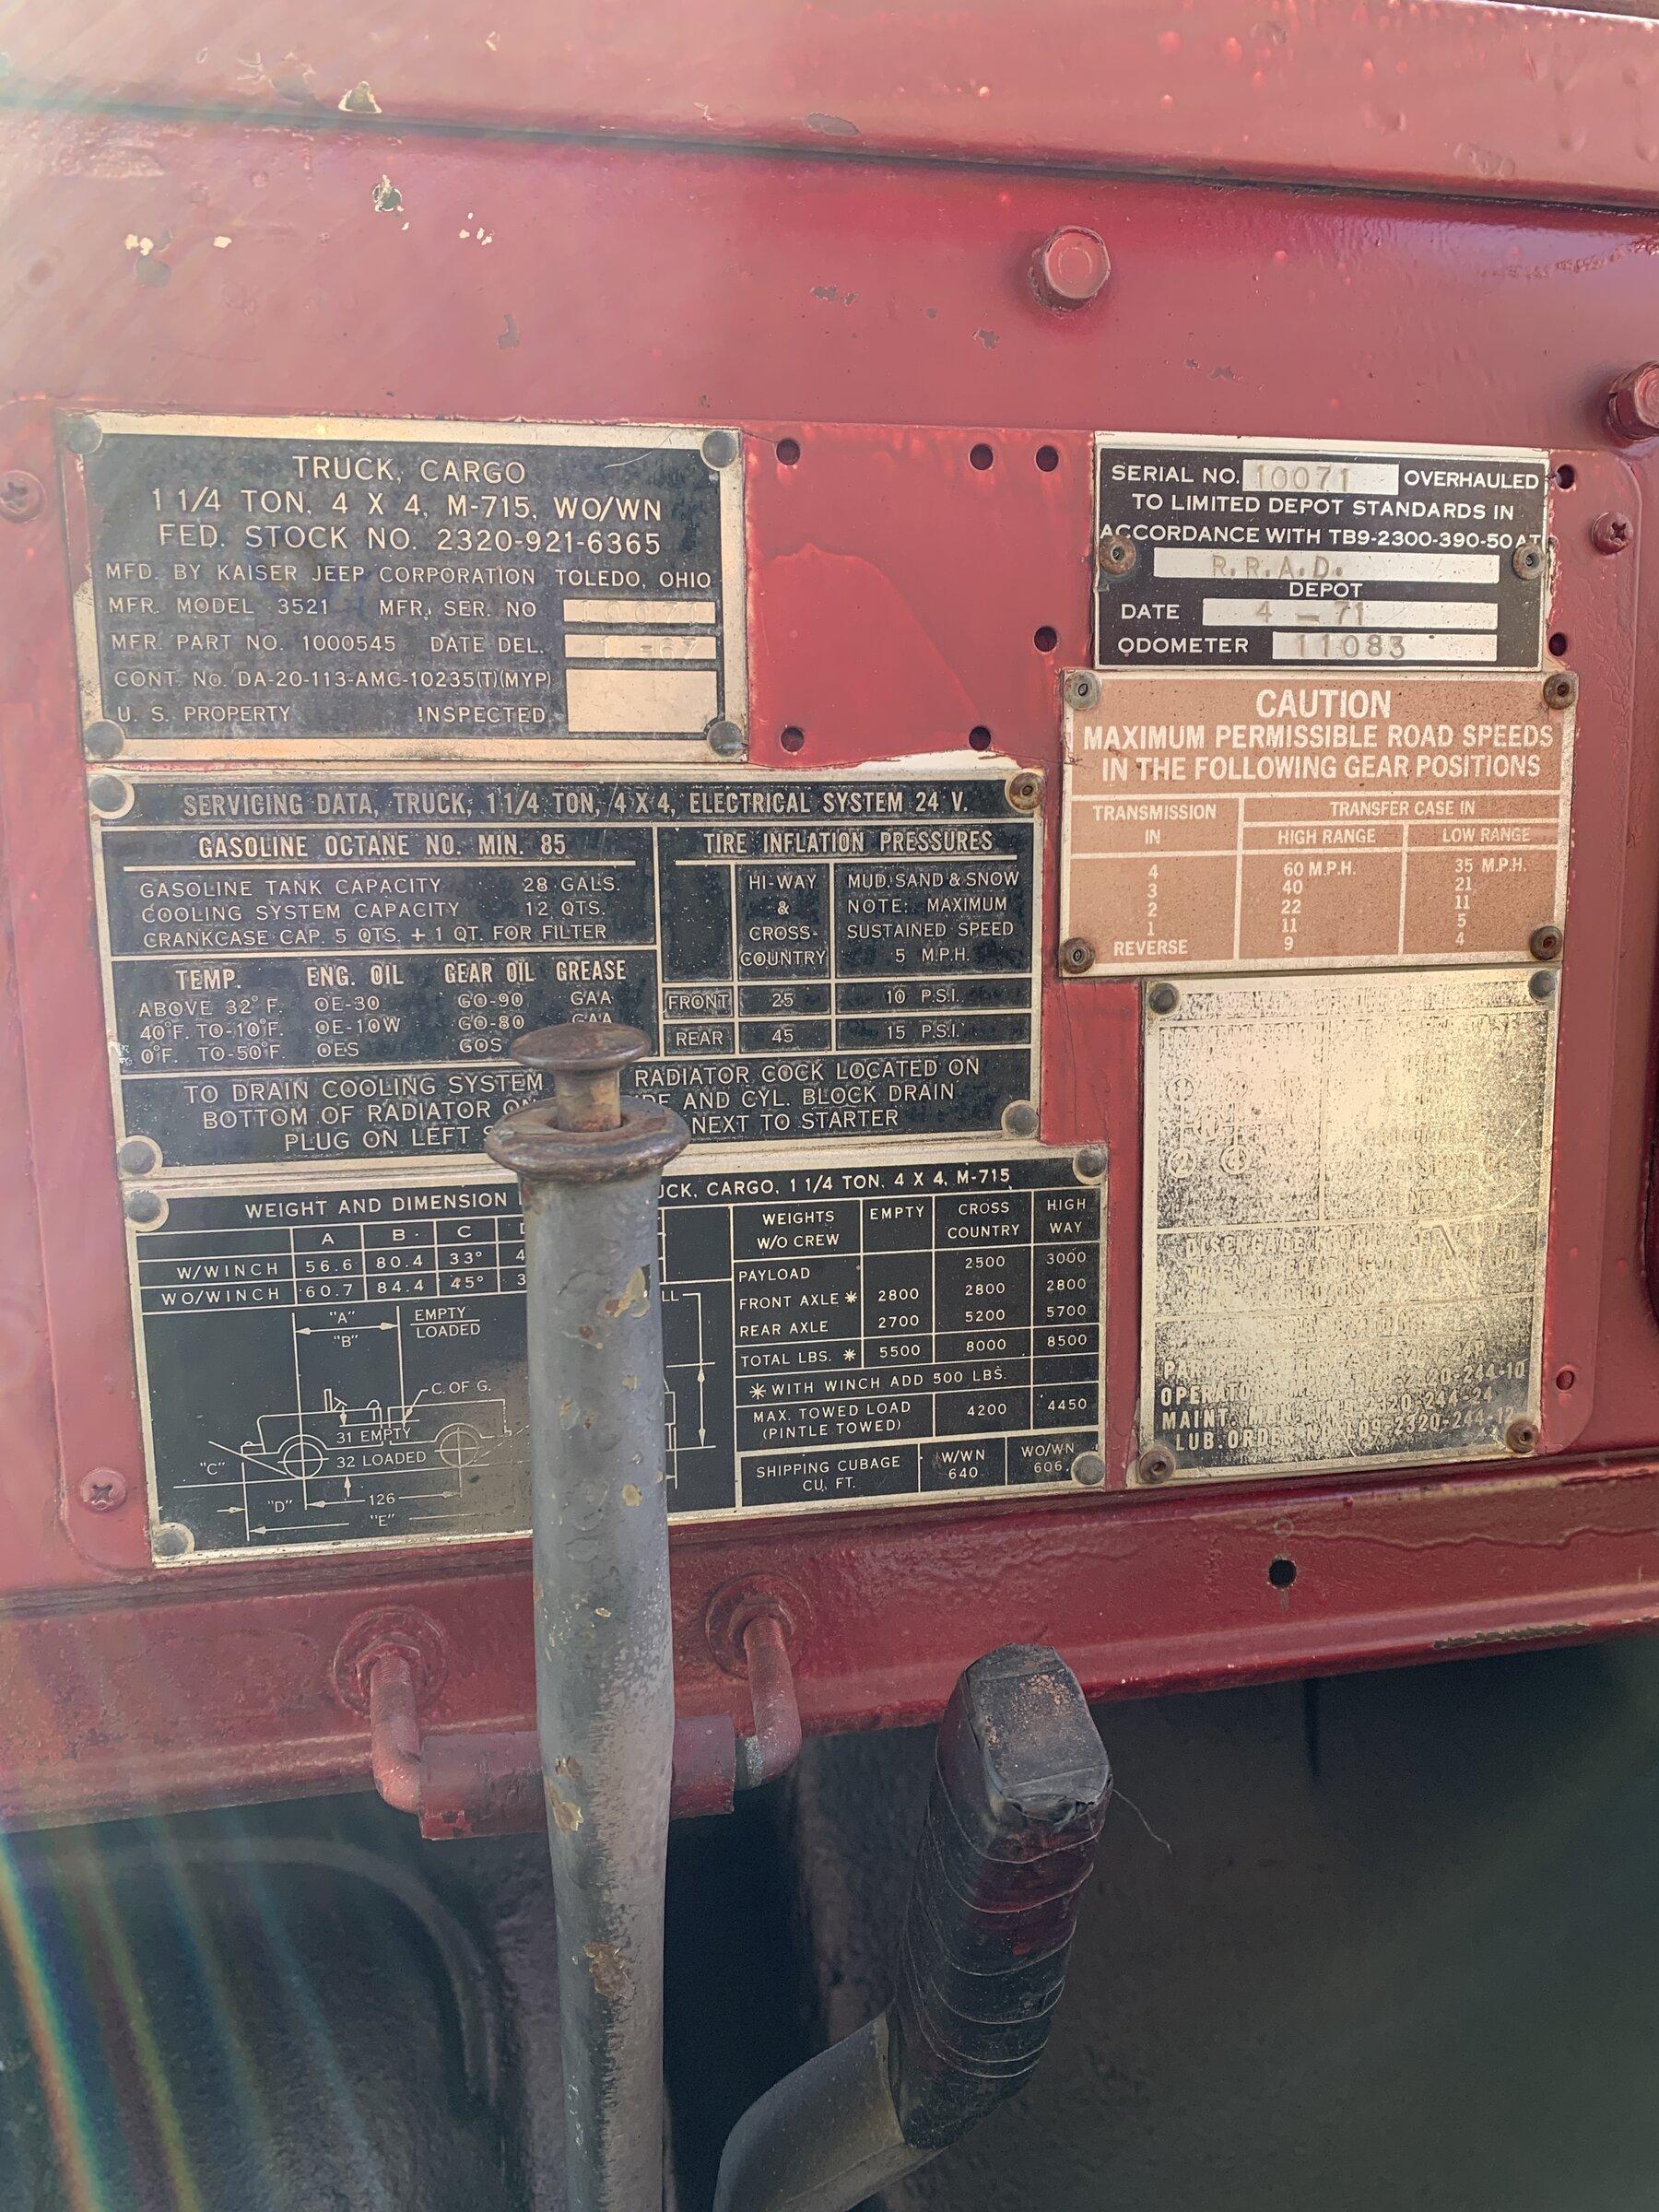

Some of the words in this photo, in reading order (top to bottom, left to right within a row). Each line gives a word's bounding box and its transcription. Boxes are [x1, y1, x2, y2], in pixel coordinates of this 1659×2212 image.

[293, 456, 402, 484] TRUCK,
[420, 460, 525, 484] CARGO
[1111, 465, 1194, 482] SERIAL
[1202, 468, 1241, 485] NO.
[1256, 465, 1350, 492] 10071
[1405, 469, 1539, 490] OVERHAULED
[153, 488, 161, 511] 1
[179, 487, 221, 512] 1/4
[241, 490, 312, 514] TON,
[331, 492, 348, 514] 4
[368, 493, 383, 515] X
[404, 493, 429, 519] 4,
[448, 494, 537, 521] M-715,
[553, 497, 662, 522] WO/WN
[1133, 493, 1164, 511] TO
[1171, 494, 1260, 513] LIMITED
[1268, 497, 1346, 515] DEPOT
[1352, 500, 1486, 521] STANDARDS
[1494, 504, 1514, 522] IN
[159, 524, 225, 547] FED.
[245, 525, 347, 549] STOCK
[368, 527, 417, 551] NO.
[437, 529, 662, 555] 2320-921-6365
[1100, 524, 1259, 544] ACCORDANCE
[1265, 527, 1321, 546] WITH
[106, 563, 159, 580] MFD.
[174, 564, 200, 580] BY
[218, 565, 297, 582] KAISER
[312, 566, 364, 582] JEEP
[379, 566, 535, 585] CORPORATION
[555, 570, 646, 589] TOLEDO,
[659, 571, 712, 588] OHIO
[1289, 582, 1363, 598] DEPOT
[177, 598, 254, 614] MODEL
[277, 599, 328, 615] 3521
[444, 601, 490, 618] SER.
[506, 601, 536, 618] NO
[1121, 604, 1180, 620] DATE
[1255, 601, 1272, 623] 4
[112, 634, 162, 651] MFR.
[177, 635, 230, 651] PART
[247, 635, 284, 652] NO.
[302, 635, 396, 652] 1000545
[430, 637, 484, 653] DATE
[499, 637, 544, 653] DEL.
[1117, 637, 1249, 653] ODOMETER
[1297, 634, 1405, 659] 11083
[184, 706, 291, 724] PROPERTY
[1256, 689, 1392, 719] CAUTION
[1083, 724, 1206, 750] MAXIMUM
[1215, 724, 1378, 748] PERMISSIBLE
[1388, 724, 1453, 748] ROAD
[1463, 724, 1554, 748] SPEEDS
[1102, 757, 1125, 782] IN
[1135, 757, 1186, 782] THE
[1194, 755, 1337, 782] FOLLOWING
[1344, 755, 1408, 780] GEAR
[1416, 754, 1541, 779] POSITIONS
[183, 793, 304, 818] SERVICING
[317, 794, 379, 818] DATA,
[394, 793, 472, 817] TRUCK,
[552, 793, 601, 816] TON,
[614, 792, 628, 815] 4
[635, 793, 650, 815] X
[657, 793, 677, 817] 4,
[688, 791, 812, 815] ELECTRICAL
[823, 791, 904, 813] SYSTEM
[915, 791, 940, 813] 24
[1092, 803, 1218, 821] TRANSMISSION
[1330, 801, 1409, 817] TRANSFER
[1414, 800, 1455, 816] CASE
[1459, 800, 1476, 816] IN
[198, 835, 308, 860] GASOLINE
[324, 835, 410, 857] OCTANE
[426, 834, 462, 856] NO.
[477, 834, 524, 856] MIN.
[539, 833, 567, 855] 85
[703, 833, 747, 853] TIRE
[762, 831, 865, 853] INFLATION
[880, 830, 994, 852] PRESSURES
[1145, 830, 1161, 845] IN
[1277, 830, 1317, 845] HIGH
[1323, 829, 1376, 844] RANGE
[1442, 828, 1475, 843] LOW
[1480, 828, 1531, 843] RANGE
[1147, 864, 1159, 880] 4
[1283, 861, 1305, 877] 60
[1454, 858, 1474, 875] 35
[140, 880, 253, 900] GASOLINE
[265, 879, 323, 896] TANK
[335, 877, 441, 896] CAPACITY
[523, 877, 548, 892] 28
[1282, 880, 1303, 896] 40
[1454, 877, 1473, 892] 21
[1112, 939, 1188, 958] REVERSE
[307, 966, 357, 988] ENG.
[371, 964, 404, 985] OIL
[443, 963, 493, 984] GEAR
[505, 962, 535, 982] OIL
[556, 959, 627, 982] GREASE
[667, 994, 729, 1010] FRONT
[771, 993, 794, 1008] 25
[691, 1115, 750, 1135] NEXT
[760, 1112, 792, 1132] TO
[801, 1109, 900, 1131] STARTER
[790, 1177, 796, 1194] 1
[805, 1174, 833, 1194] 1/4
[894, 1171, 905, 1187] 4
[913, 1171, 924, 1186] X
[957, 1168, 1010, 1184] M-715
[244, 1200, 328, 1220] WEIGHT
[338, 1198, 382, 1214] AND
[392, 1192, 508, 1212] DIMENSION
[869, 1205, 925, 1221] EMPTY
[959, 1201, 1010, 1216] CROSS
[1046, 1198, 1087, 1211] HIGH
[762, 1210, 835, 1226] WEIGHTS
[176, 1263, 279, 1280] W/WINCH
[305, 1258, 353, 1274] 56.6
[376, 1253, 424, 1269] 80.4
[738, 1266, 811, 1283] PAYLOAD
[964, 1255, 1006, 1269] 2500
[1046, 1251, 1087, 1265] 3000
[940, 1449, 986, 1464] W/WN
[1020, 1443, 1075, 1457] WO/WN
[756, 1461, 830, 1478] SHIPPING
[837, 1455, 901, 1473] CUBAGE
